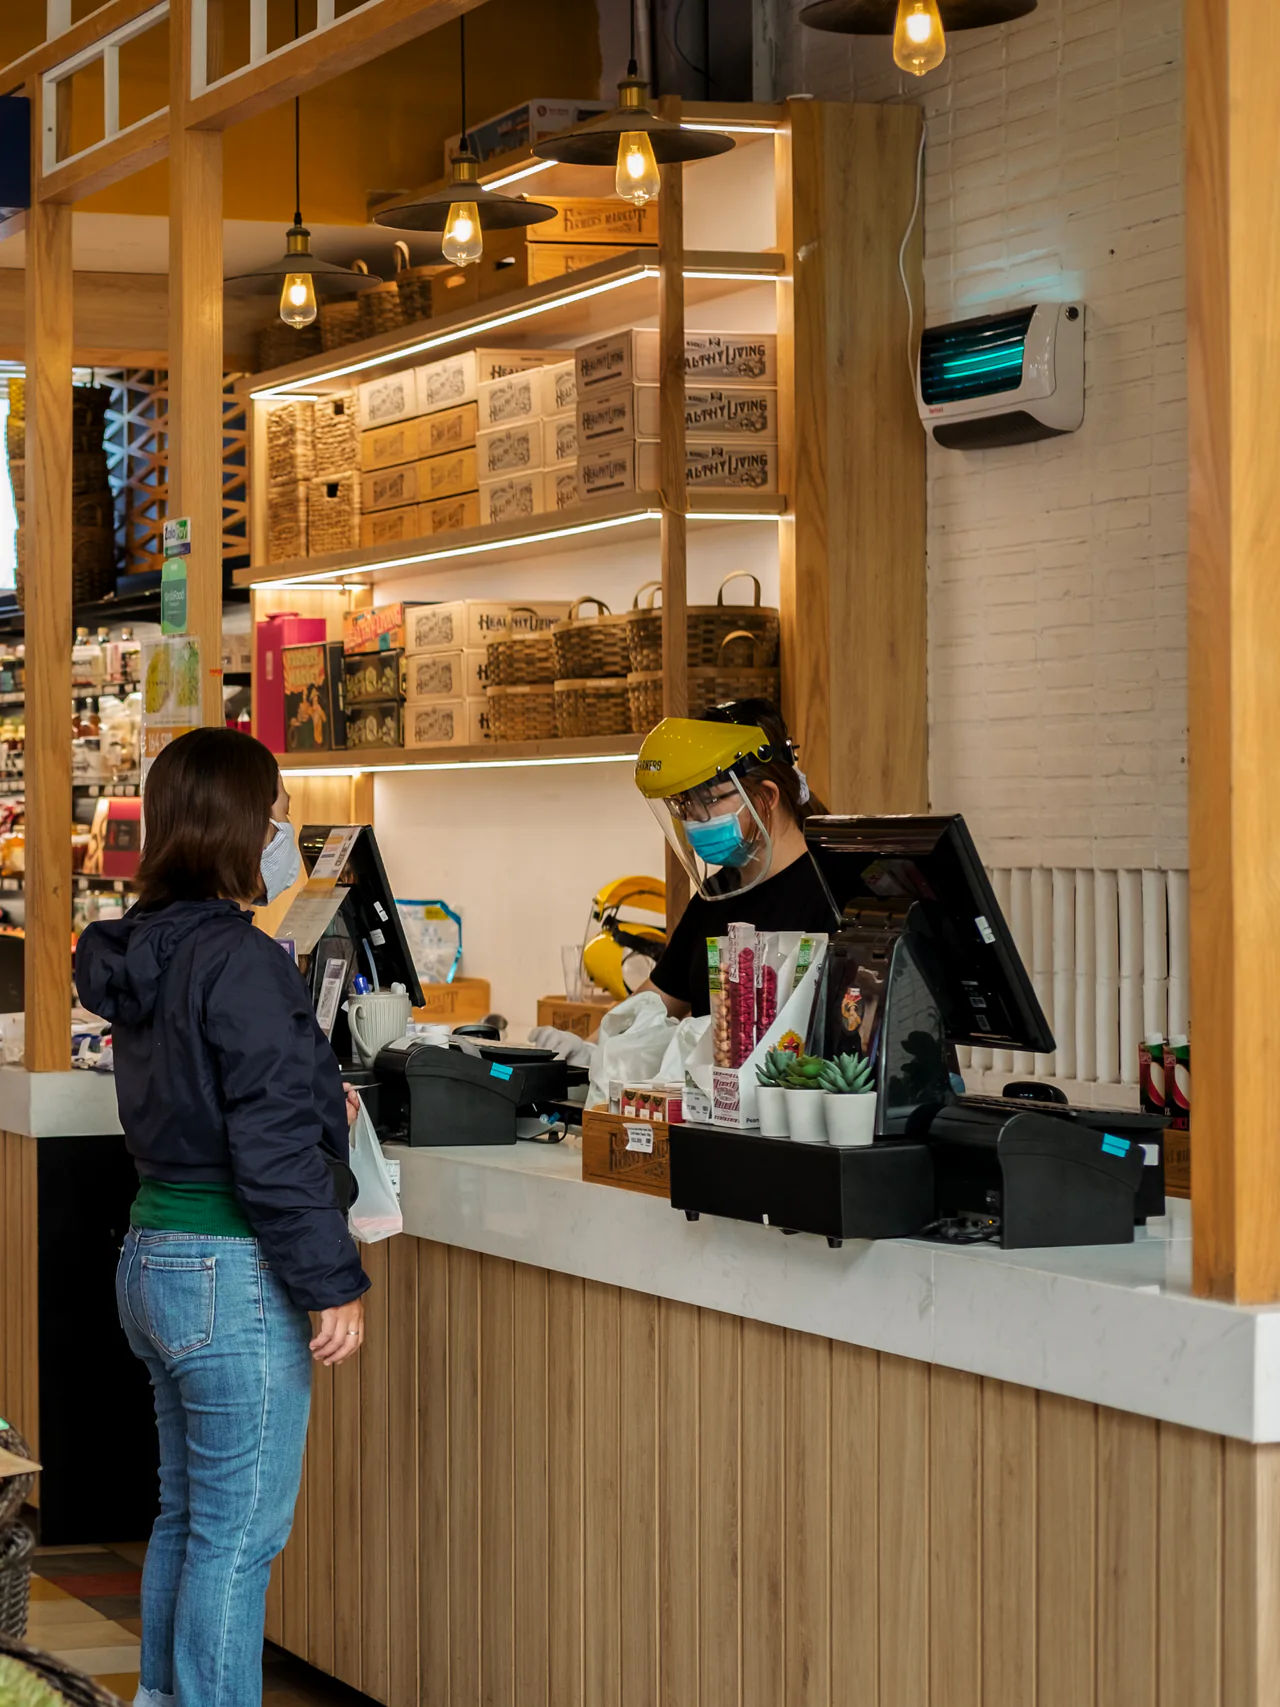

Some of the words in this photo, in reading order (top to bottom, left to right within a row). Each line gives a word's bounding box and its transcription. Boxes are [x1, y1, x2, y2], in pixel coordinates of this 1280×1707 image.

[684, 350, 725, 370] ALTHY
[726, 343, 767, 366] LIVING
[685, 404, 726, 425] ALTHY
[727, 398, 768, 421] LIVING
[686, 460, 727, 480] ALTHY
[727, 454, 768, 477] LIVING
